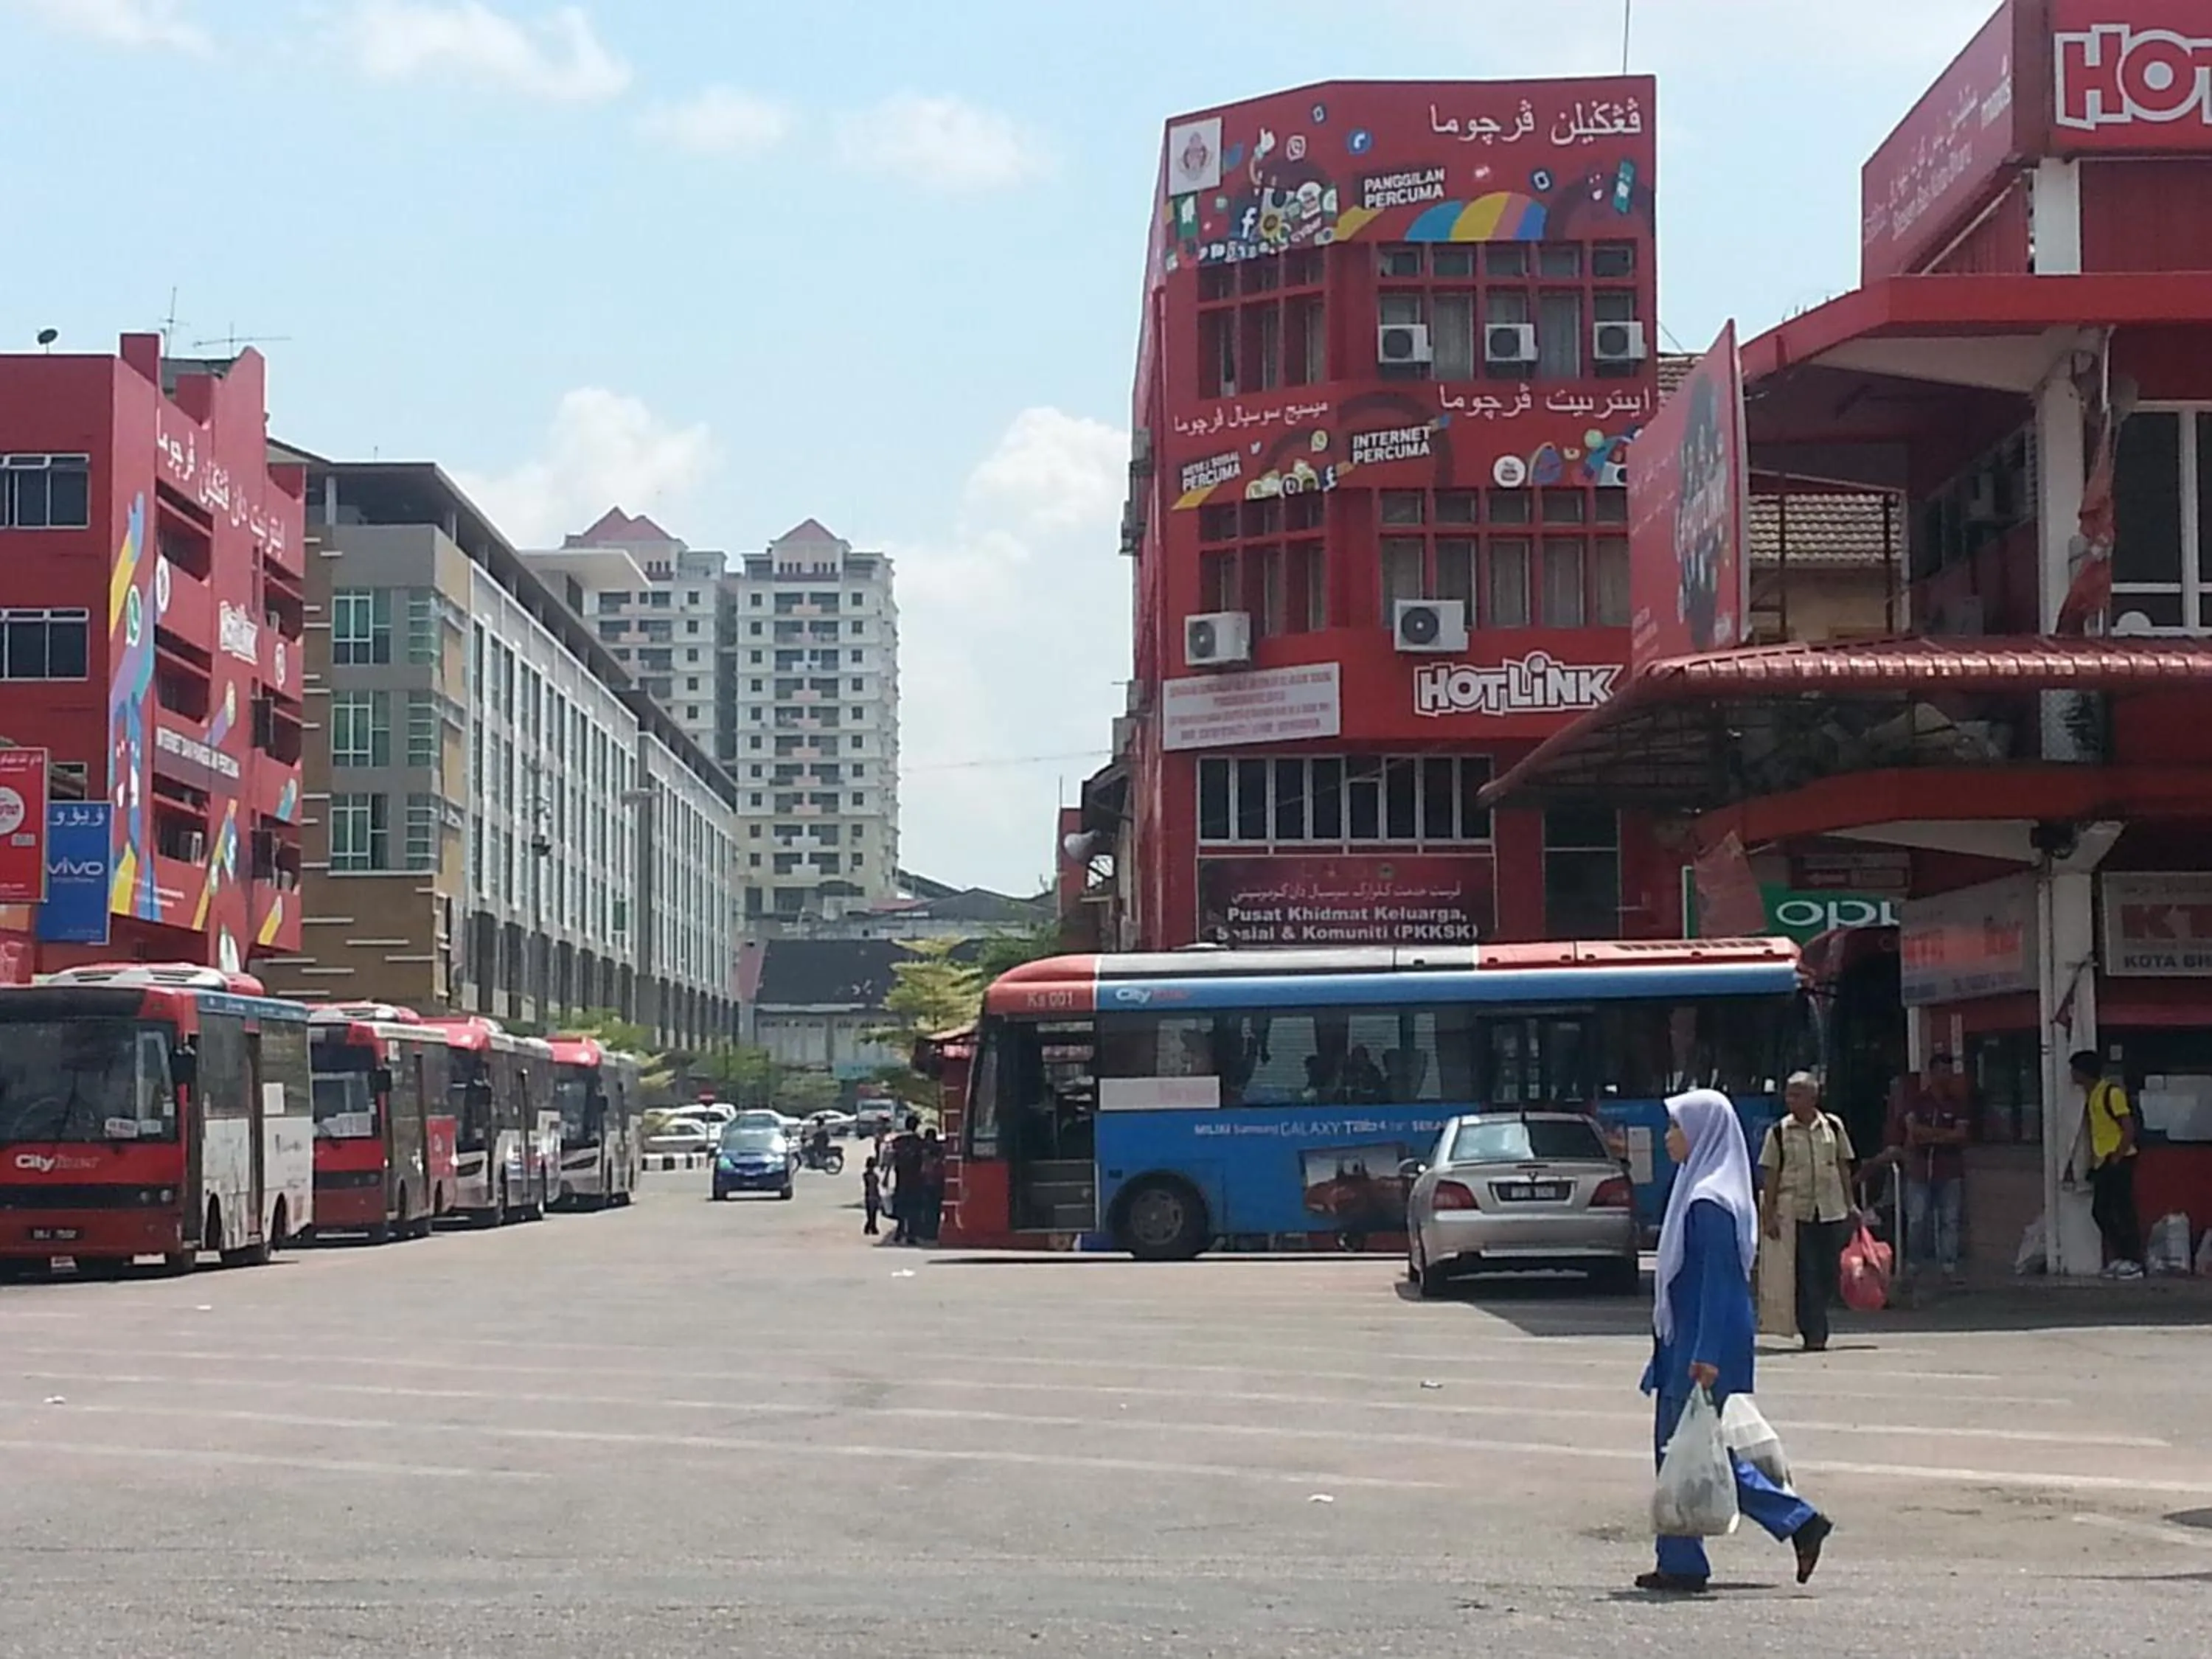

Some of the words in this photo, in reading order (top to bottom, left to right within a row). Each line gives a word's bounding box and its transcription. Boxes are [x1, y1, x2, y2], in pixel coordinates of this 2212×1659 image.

[1364, 167, 1445, 192] PANGGILAN
[1364, 184, 1444, 209] PERCUMA
[1352, 425, 1432, 449] INTERNET
[1352, 441, 1430, 465] PERCUMA
[1182, 462, 1242, 492] PERCUMA
[47, 856, 104, 875] vivo
[1227, 907, 1281, 922] Pusat
[1287, 906, 1368, 922] Khidmat
[1374, 907, 1467, 923] Keluarga,
[1217, 925, 1275, 941] Ssial
[1281, 925, 1296, 940] &
[1302, 924, 1388, 940] Komuniti
[1394, 924, 1478, 941] (PKKSK)
[2124, 955, 2177, 968] KOTA
[1280, 1121, 1340, 1137] GALAXY
